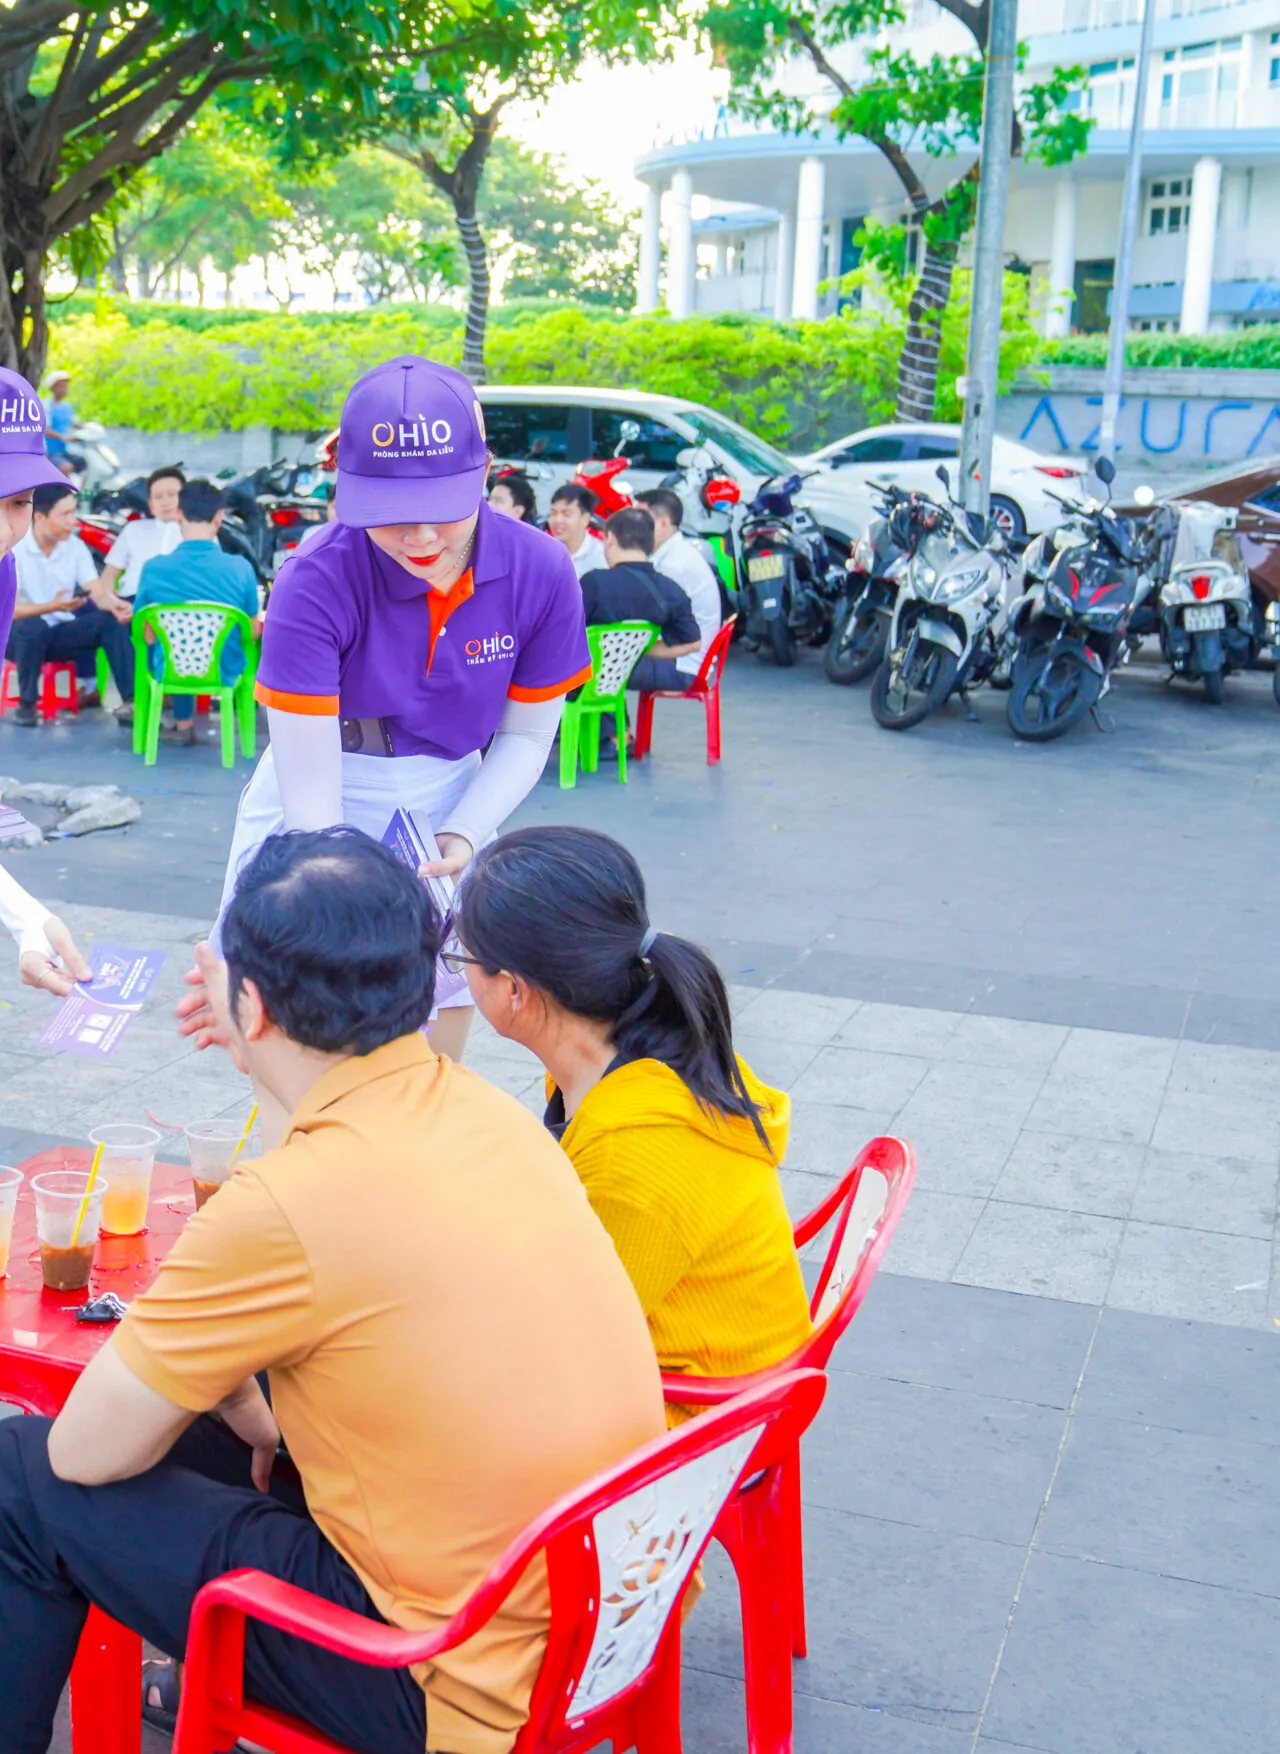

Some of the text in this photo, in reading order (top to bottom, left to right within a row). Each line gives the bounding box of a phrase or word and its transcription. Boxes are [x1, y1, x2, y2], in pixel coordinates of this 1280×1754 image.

[372, 418, 452, 448] OHIO
[401, 449, 425, 457] KHÁM
[465, 632, 515, 656] OHIO
